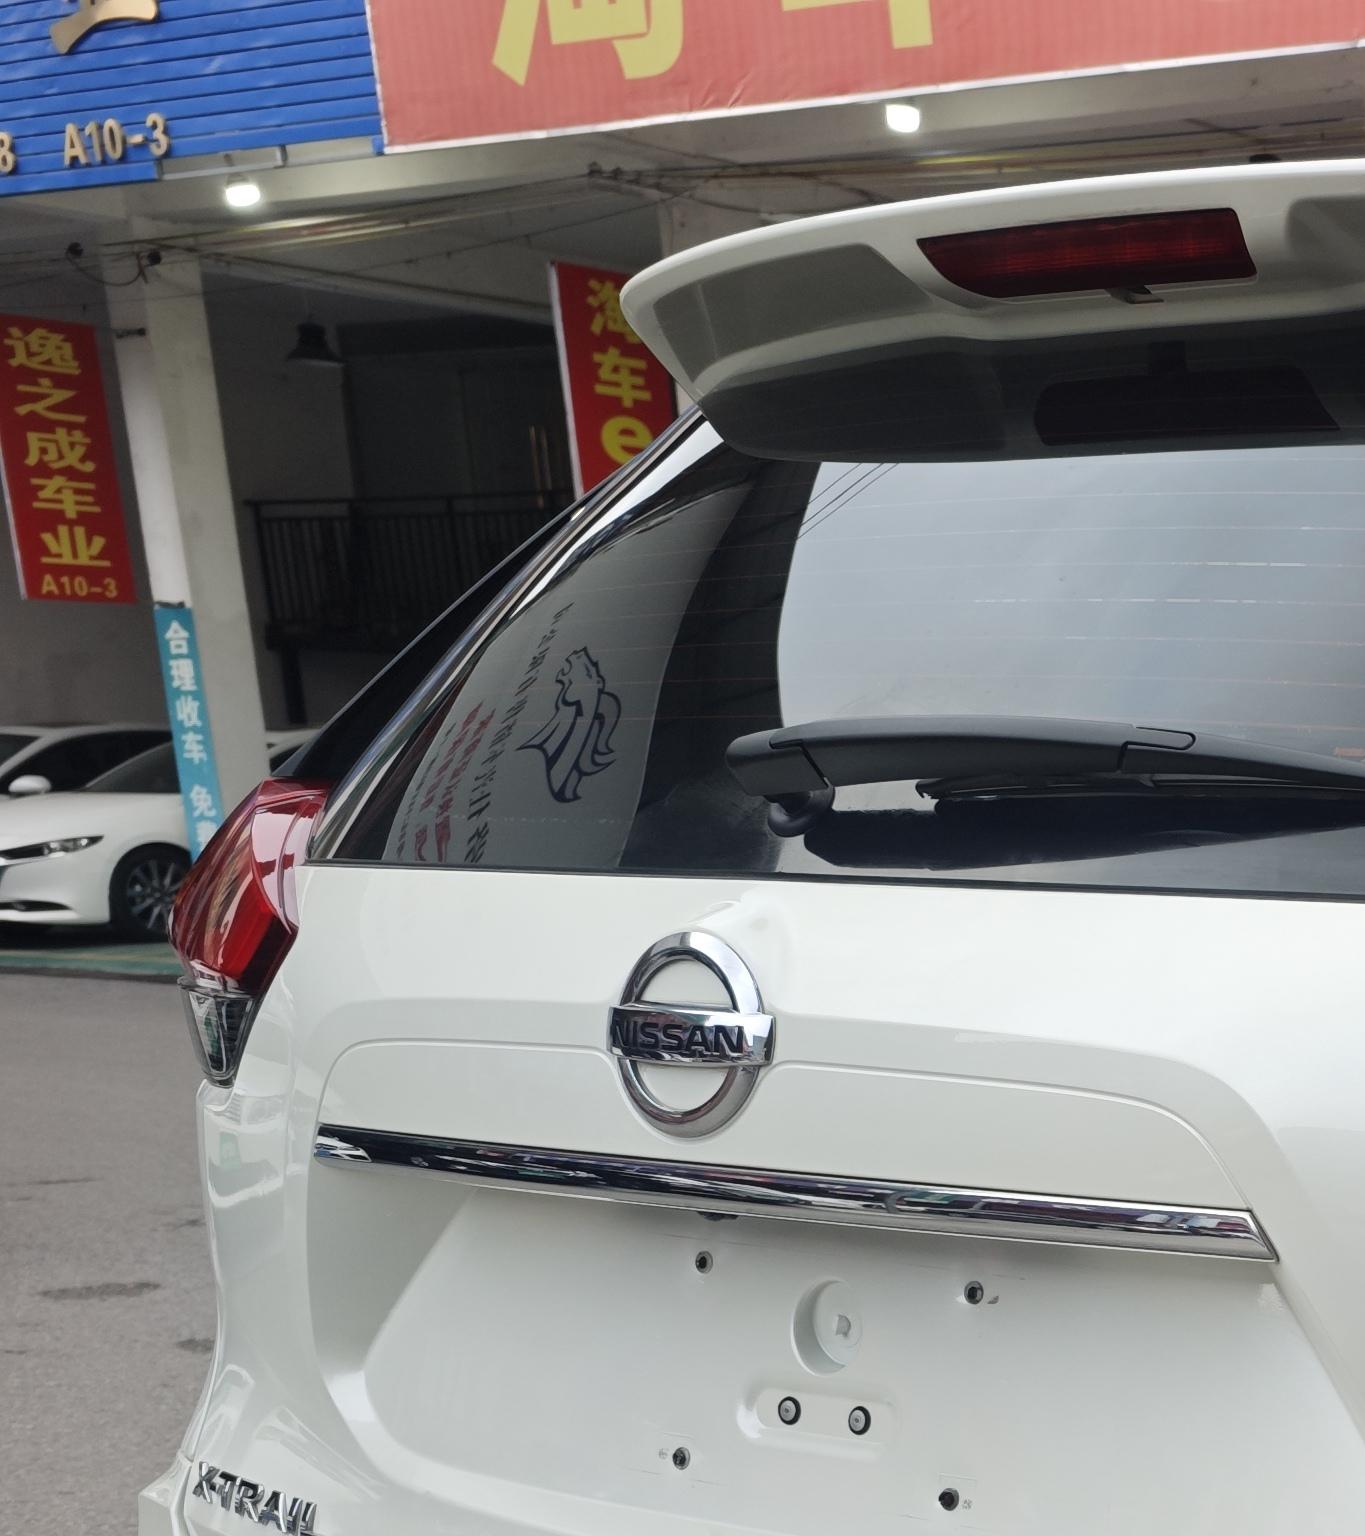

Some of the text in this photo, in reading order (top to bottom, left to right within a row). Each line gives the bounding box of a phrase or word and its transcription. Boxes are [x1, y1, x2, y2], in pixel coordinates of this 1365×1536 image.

[64, 112, 170, 168] A10-3
[4, 325, 112, 568] 逸之成车业
[41, 573, 118, 599] A10-3
[164, 618, 207, 766] 合理收车
[611, 1016, 745, 1058] NISSAN
